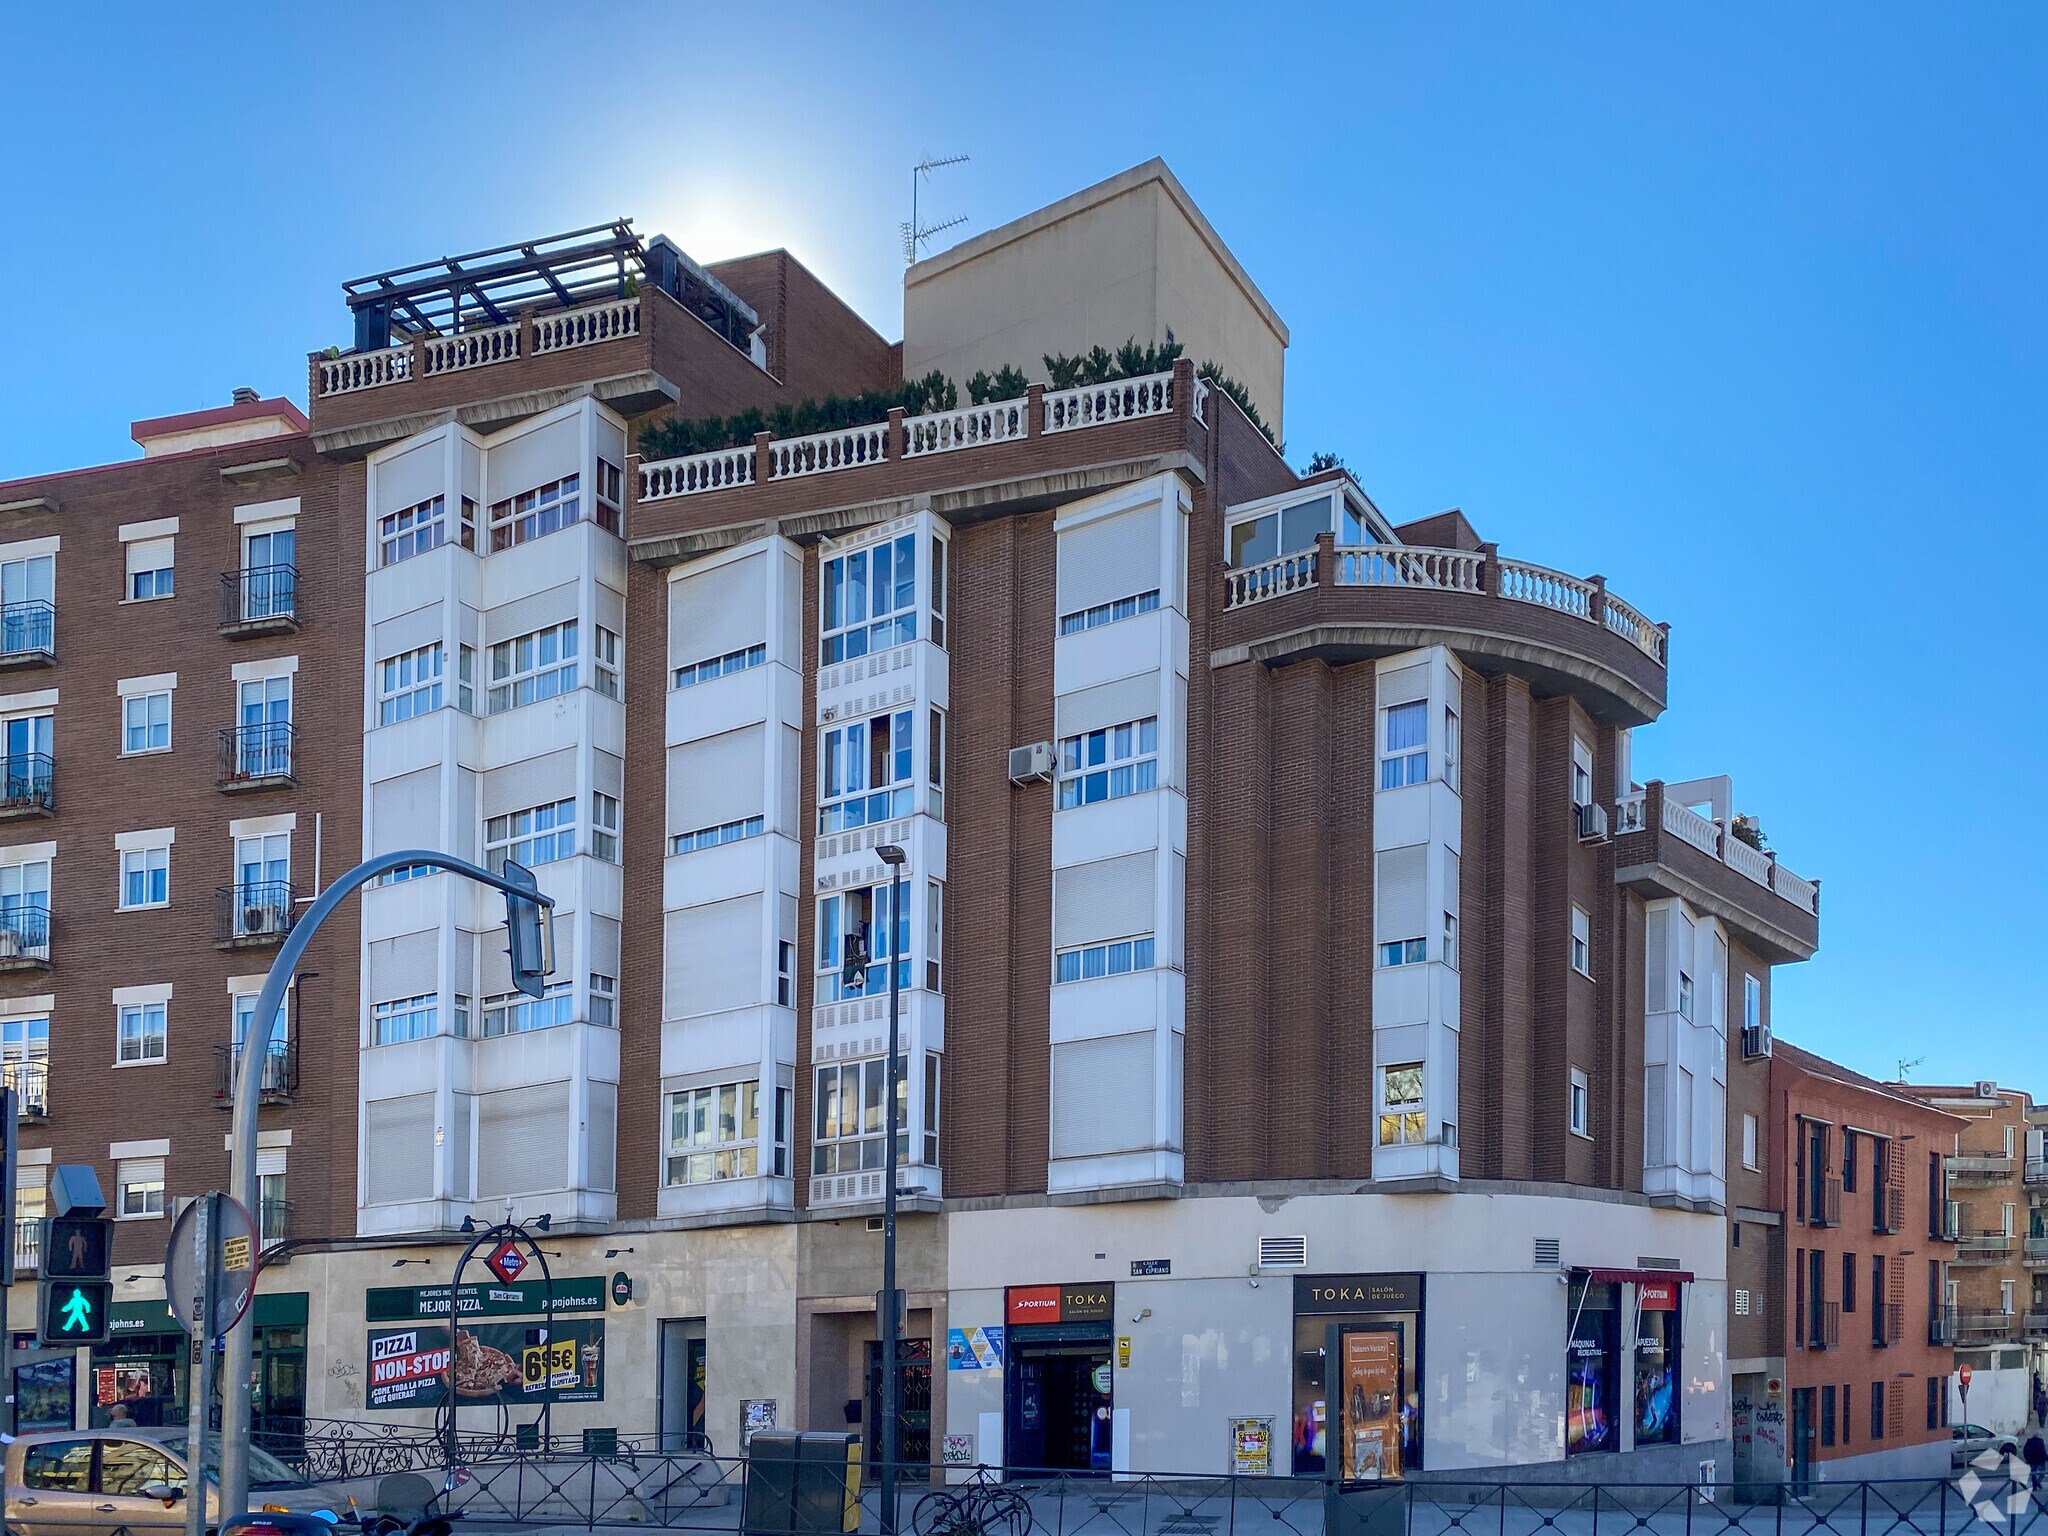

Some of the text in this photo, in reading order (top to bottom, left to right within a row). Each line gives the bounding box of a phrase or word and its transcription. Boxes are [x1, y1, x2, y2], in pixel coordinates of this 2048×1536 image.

[503, 1257, 519, 1267] Metro
[1145, 1267, 1169, 1275] CIPRIANO
[420, 1289, 442, 1297] MEJORES
[1312, 1288, 1365, 1300] TOKA
[1572, 1286, 1594, 1297] TOA
[420, 1300, 451, 1313] MEJOR
[541, 1296, 598, 1309] ppajohns.es
[1013, 1294, 1107, 1310] SPORTIUM TOKA
[375, 1336, 413, 1357] PIZZA
[1571, 1338, 1595, 1349] MÁQUINAS
[1637, 1338, 1659, 1346] APUESTAS
[1642, 1346, 1664, 1354] DEPORTIVAS
[375, 1350, 450, 1382] NON-STOP
[392, 1383, 408, 1392] TODA
[409, 1381, 417, 1389] LA
[418, 1378, 436, 1388] PIZZA
[374, 1390, 416, 1404] QUE QUIERAS!
